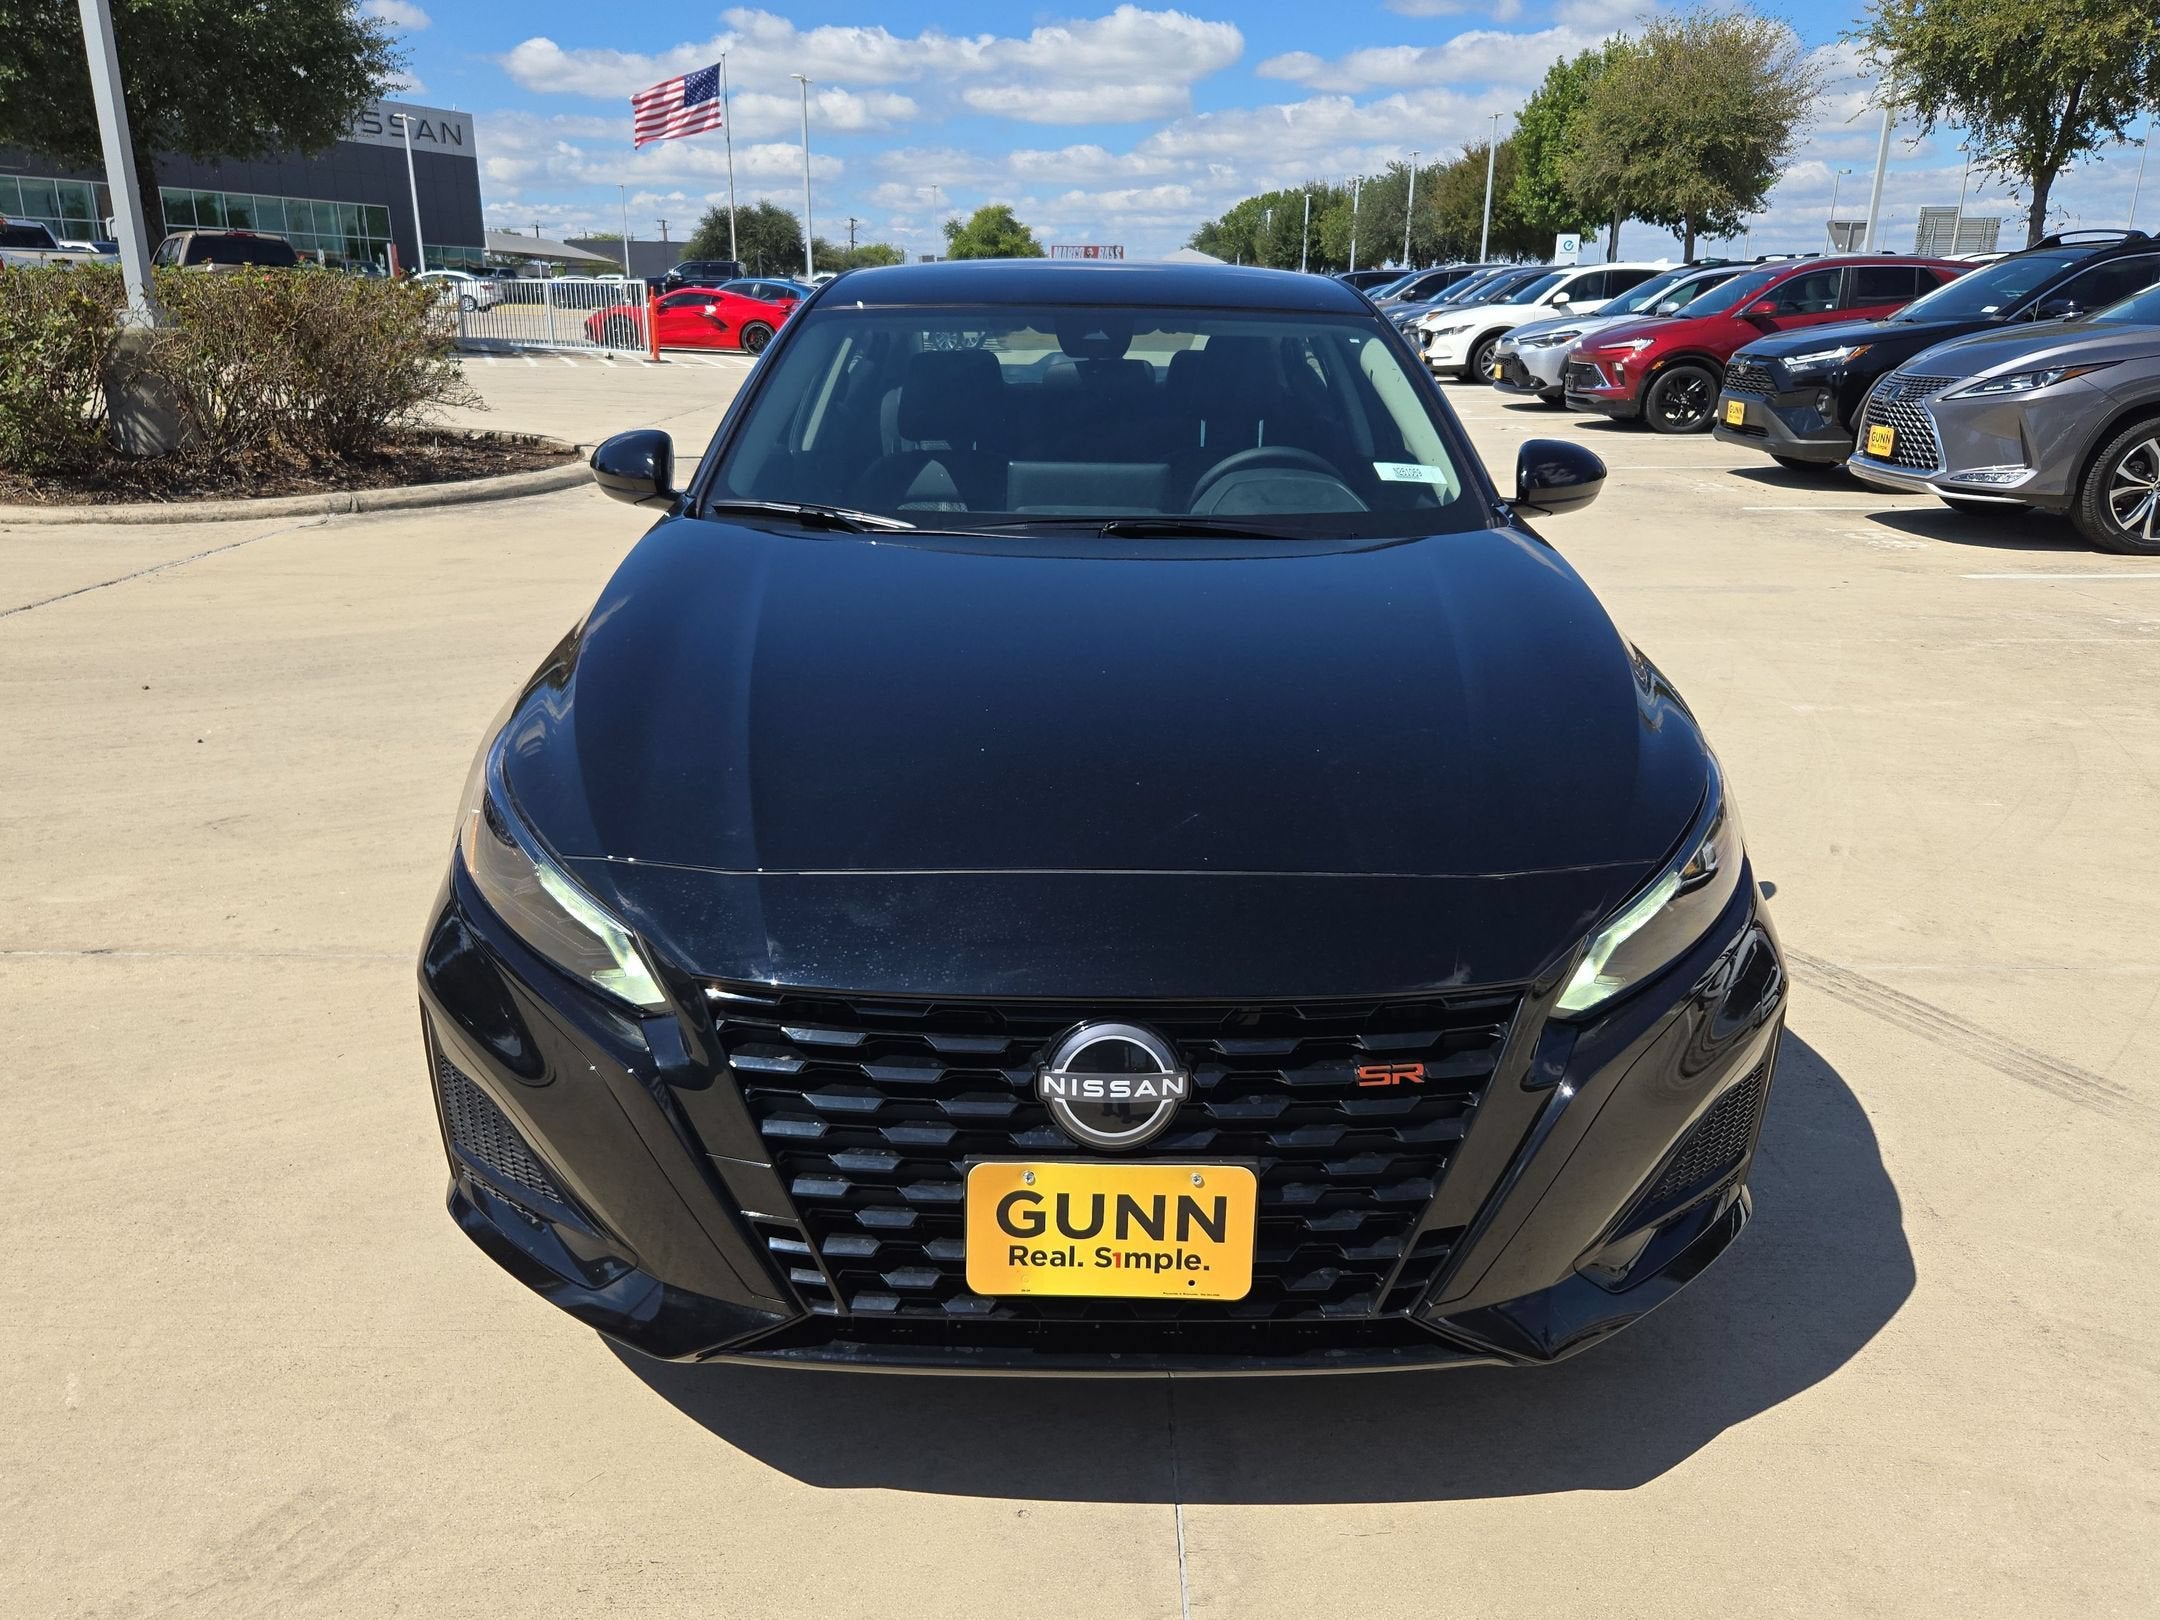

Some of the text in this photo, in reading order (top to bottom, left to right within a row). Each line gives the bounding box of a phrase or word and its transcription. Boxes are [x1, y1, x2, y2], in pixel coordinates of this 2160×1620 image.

[349, 110, 463, 146] ISSAN
[1872, 432, 1891, 444] GUNN
[1357, 1062, 1425, 1086] SR
[1043, 1075, 1184, 1098] NISSAN
[996, 1190, 1226, 1243] GUNN
[1008, 1245, 1083, 1268] Real.
